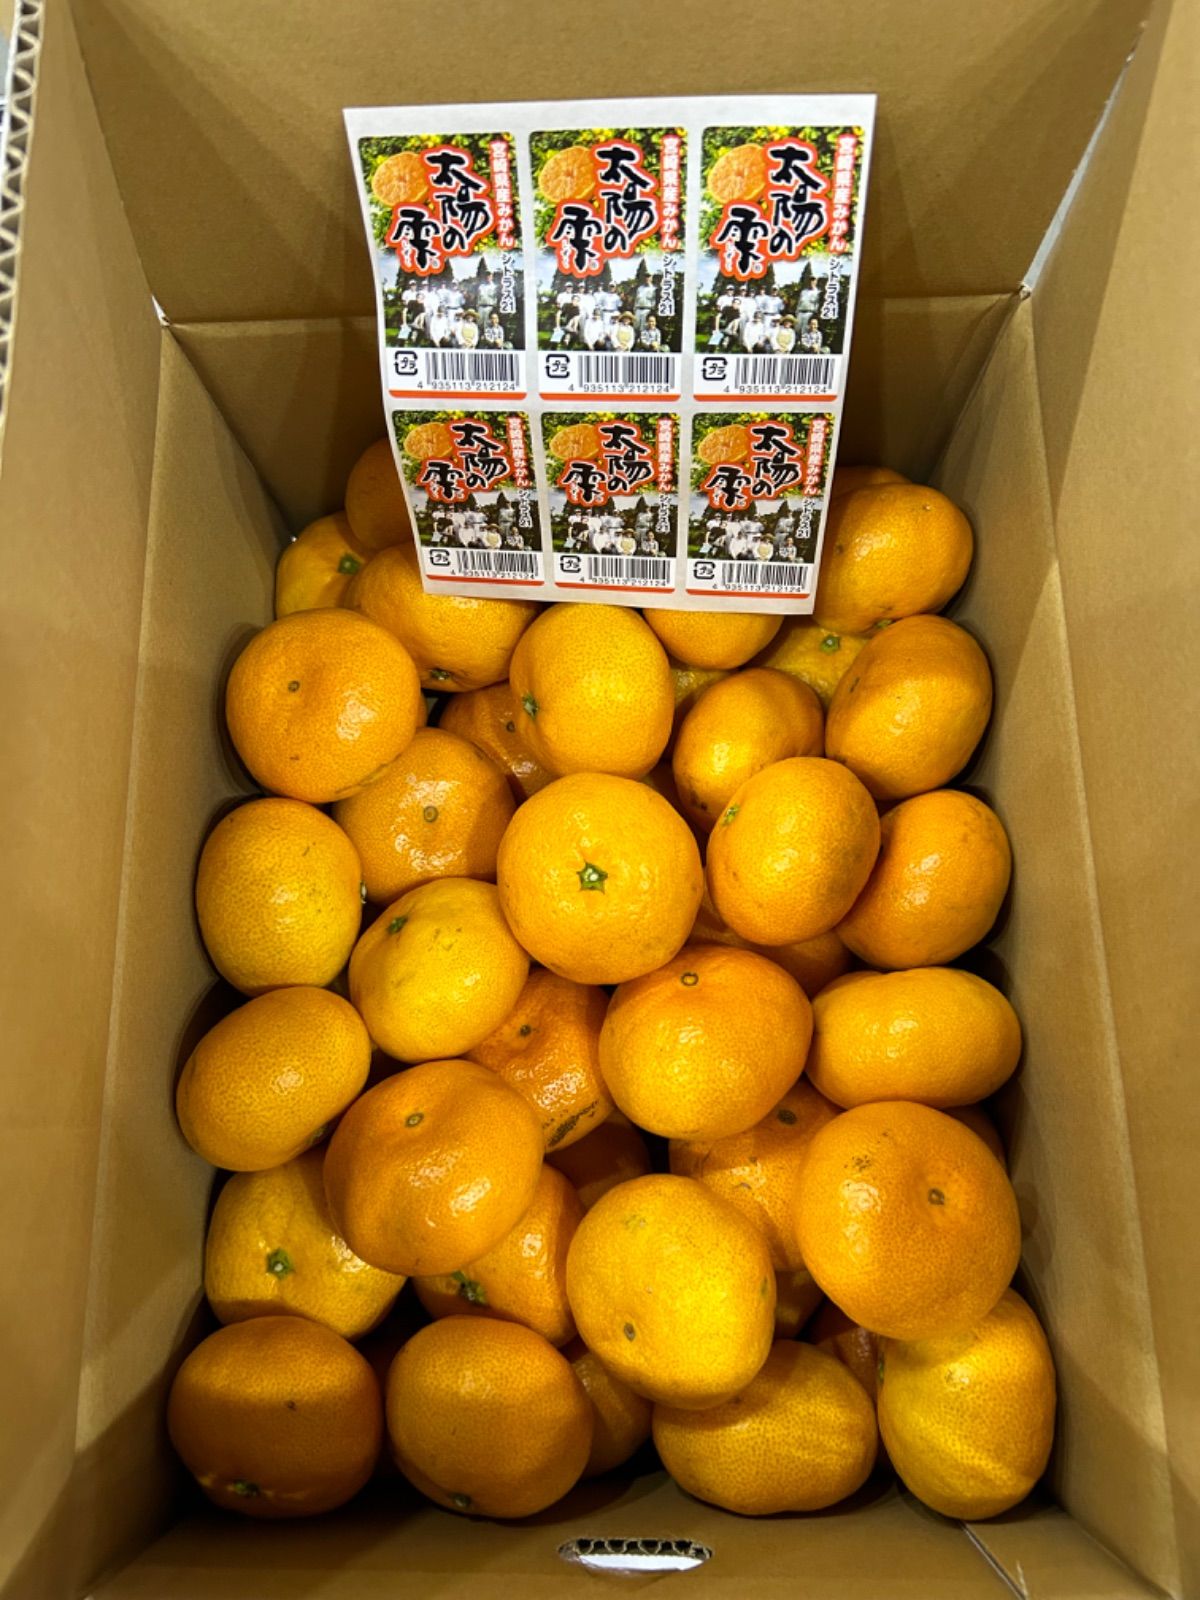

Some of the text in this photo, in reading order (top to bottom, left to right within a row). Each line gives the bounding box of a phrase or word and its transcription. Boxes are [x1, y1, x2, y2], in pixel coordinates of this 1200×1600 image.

[391, 208, 440, 269] 雫
[552, 206, 602, 271] 雫
[718, 208, 769, 274] 雫
[500, 253, 516, 314] シトラス21
[659, 254, 676, 316] シトラス21
[821, 257, 842, 319] シトラス21
[422, 462, 464, 499] 雫
[563, 463, 606, 502] 雫
[706, 466, 751, 507] 雫
